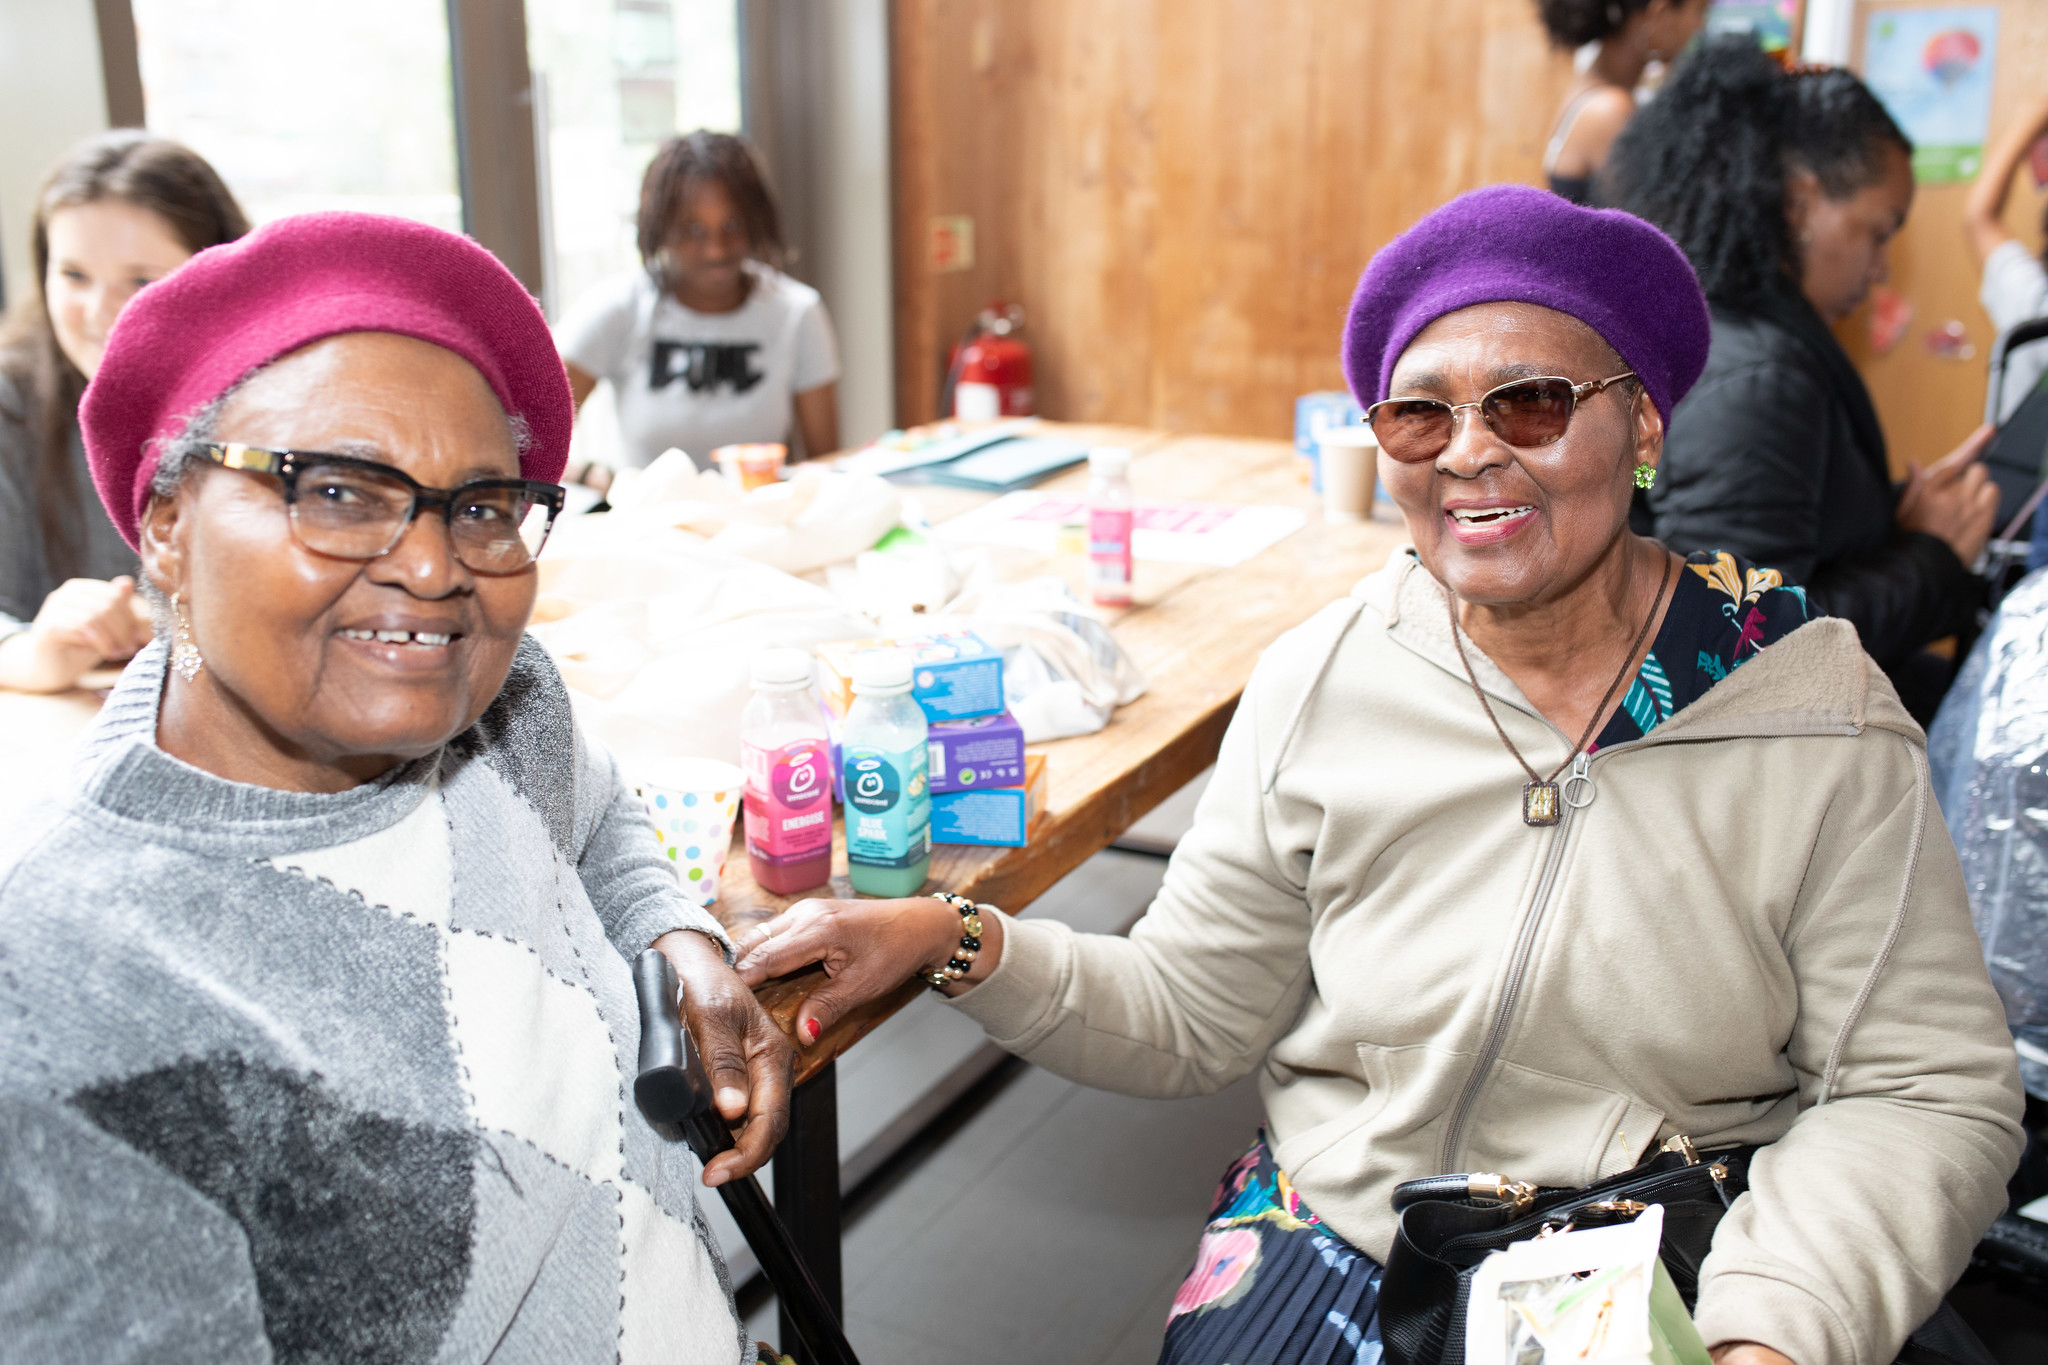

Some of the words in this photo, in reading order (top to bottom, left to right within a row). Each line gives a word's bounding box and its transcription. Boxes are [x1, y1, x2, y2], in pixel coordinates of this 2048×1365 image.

[854, 796, 889, 807] innocent
[859, 816, 884, 830] BLUE
[857, 827, 888, 841] SPARK
